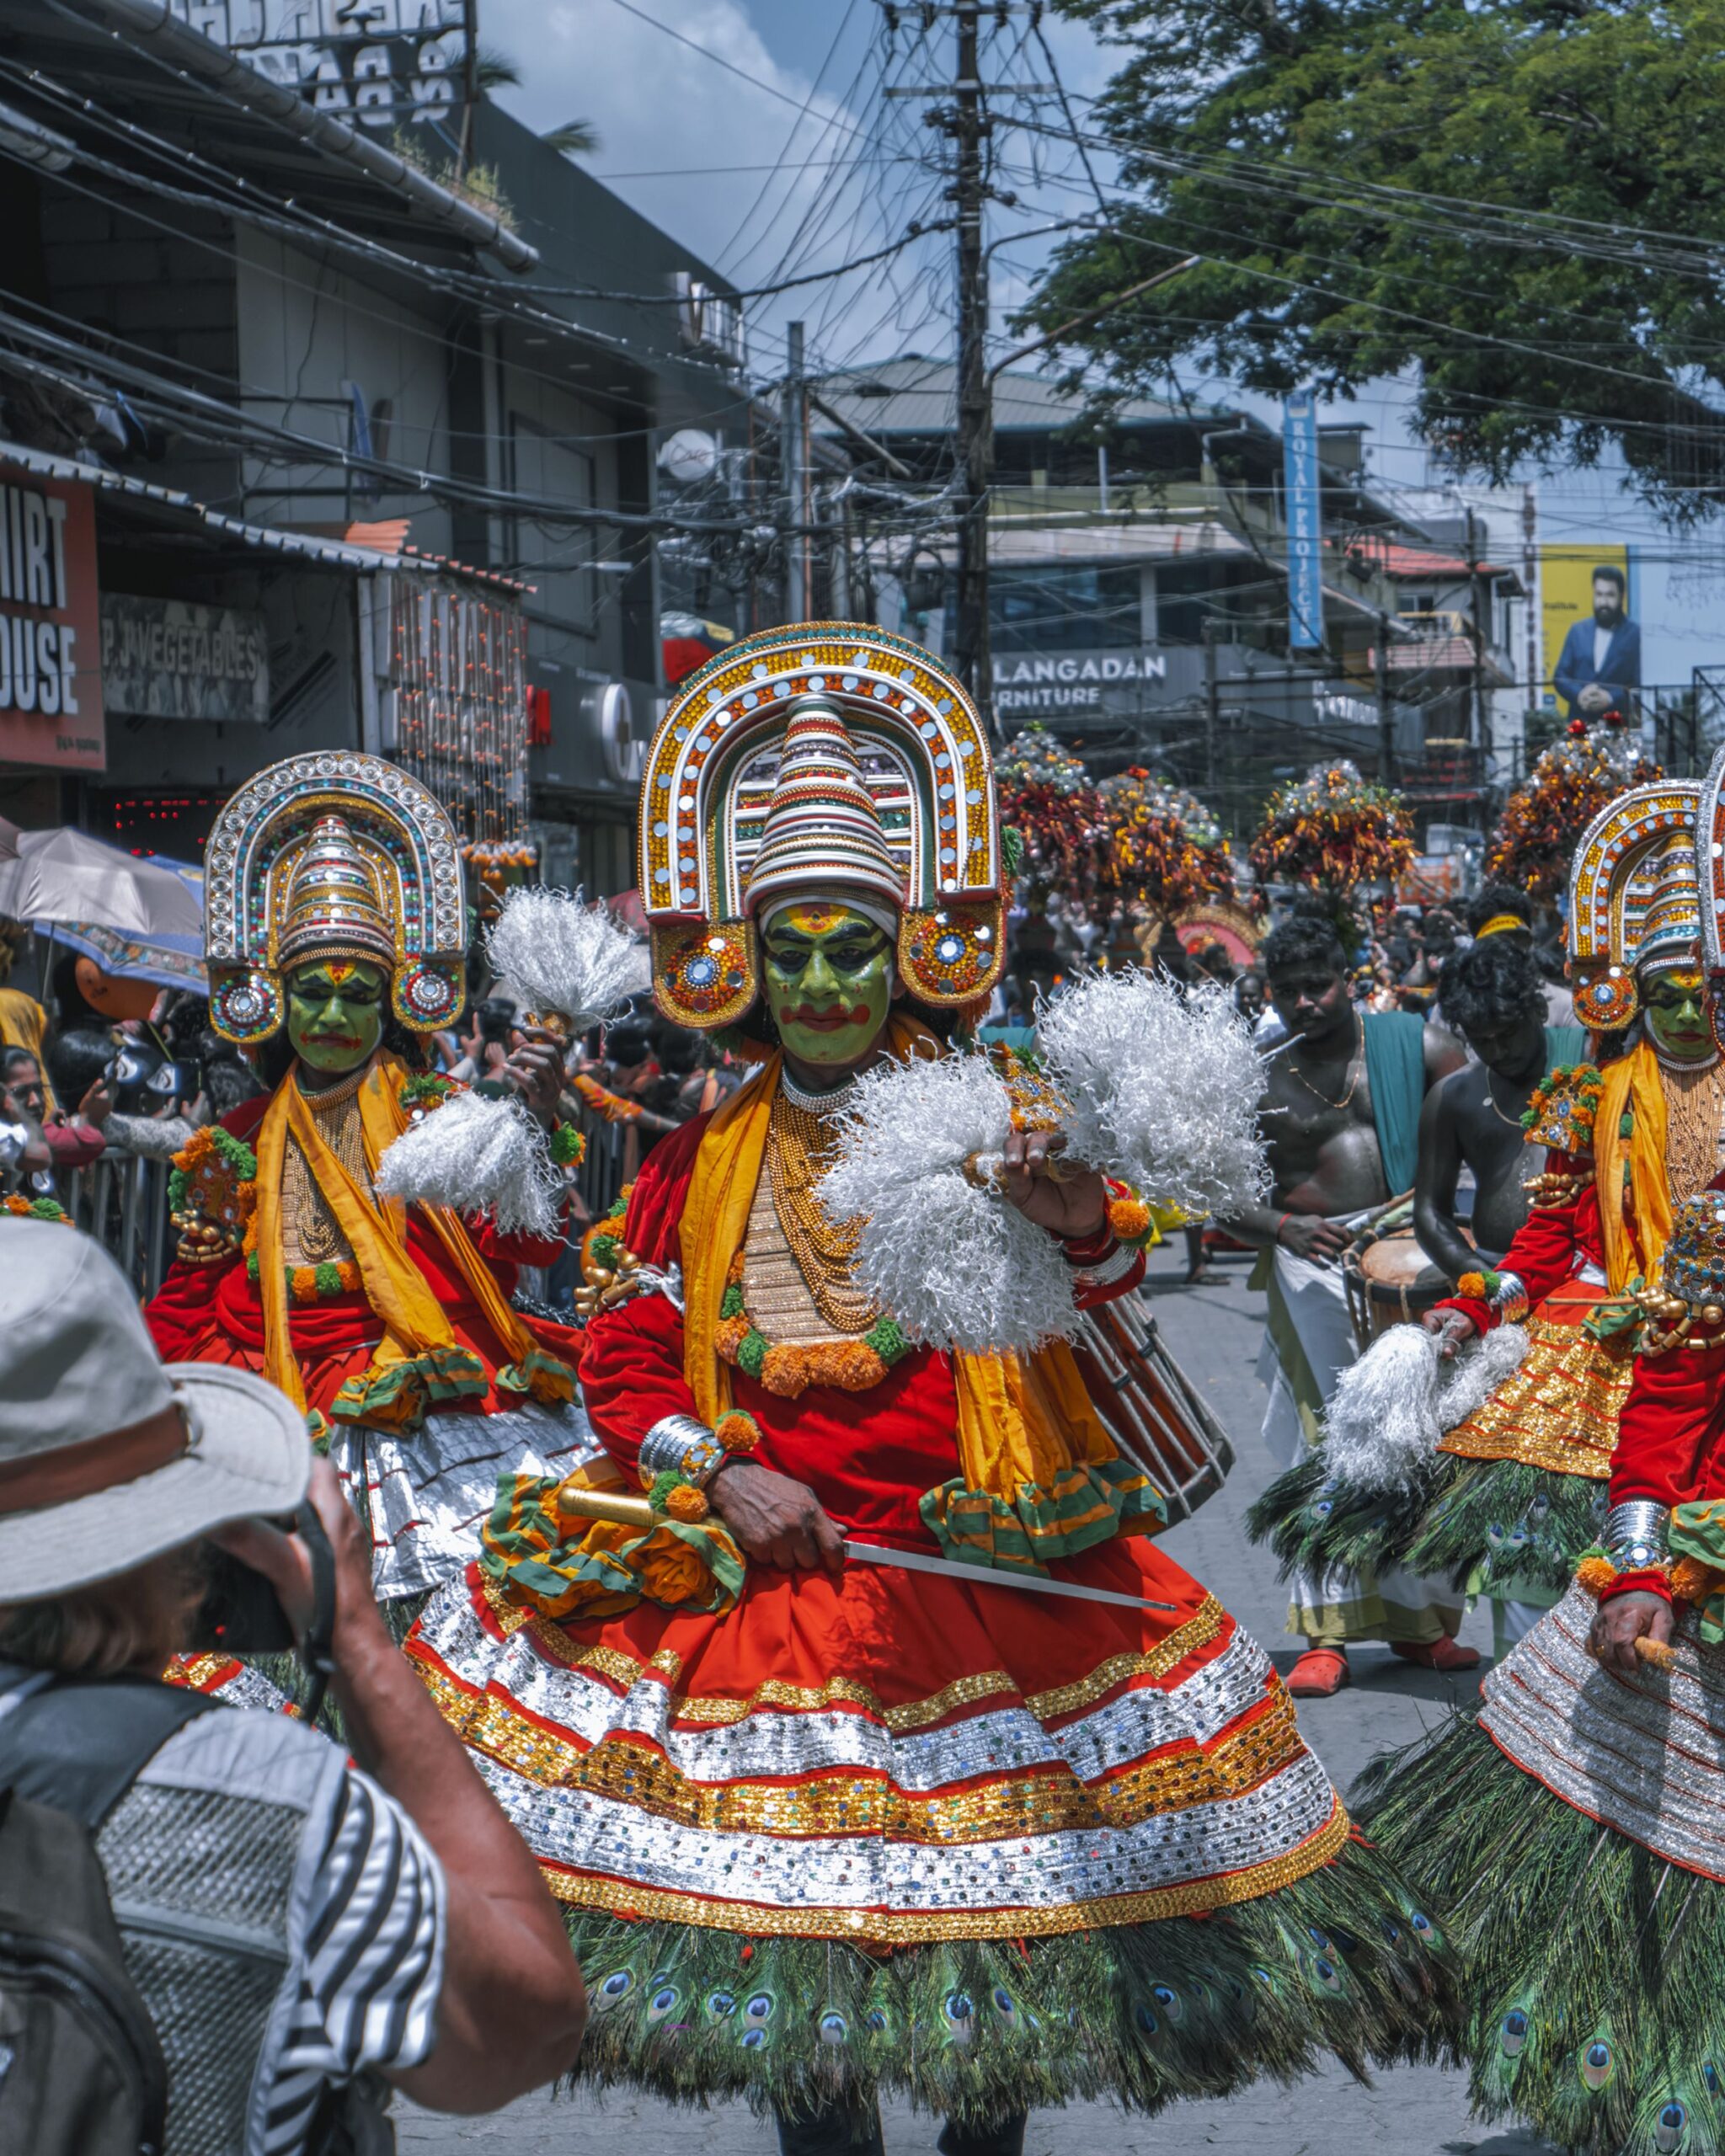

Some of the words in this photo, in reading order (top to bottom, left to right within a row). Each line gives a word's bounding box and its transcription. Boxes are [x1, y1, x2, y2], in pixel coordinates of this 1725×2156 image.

[1292, 420, 1308, 503] ROYAL
[1295, 507, 1312, 639] PROJECTS
[137, 621, 258, 681] VEGETABLES
[992, 655, 1167, 684] LANGADAN
[991, 687, 1100, 707] RNITURE
